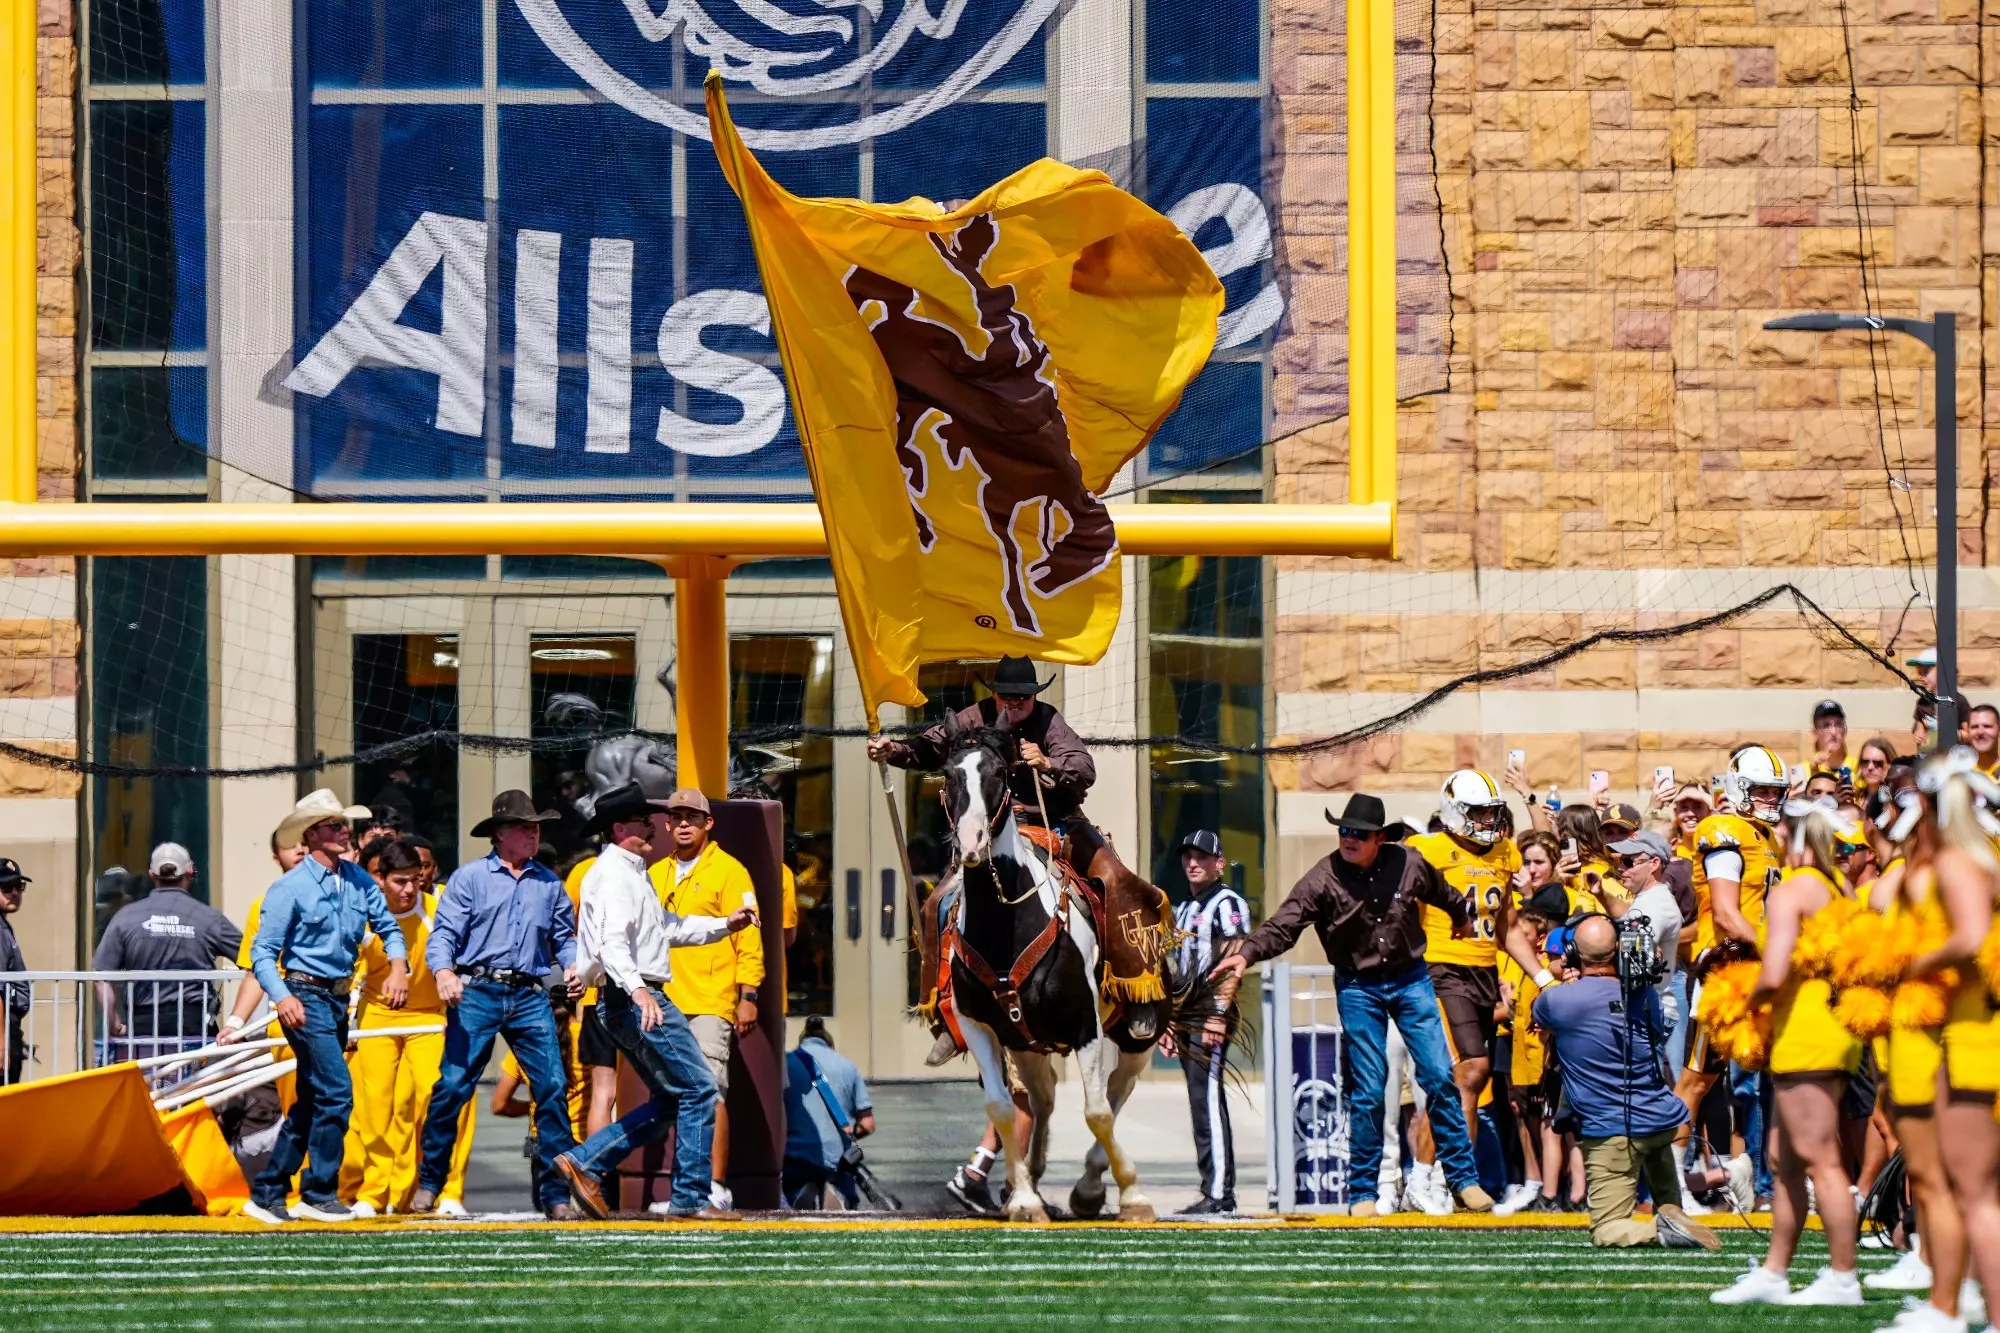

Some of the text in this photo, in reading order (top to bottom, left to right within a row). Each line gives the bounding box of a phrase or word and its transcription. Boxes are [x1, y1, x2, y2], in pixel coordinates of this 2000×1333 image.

[280, 182, 1285, 457] Allse
[150, 914, 180, 924] IED
[150, 924, 195, 934] IVERSAL
[1295, 1171, 1351, 1192] NC
